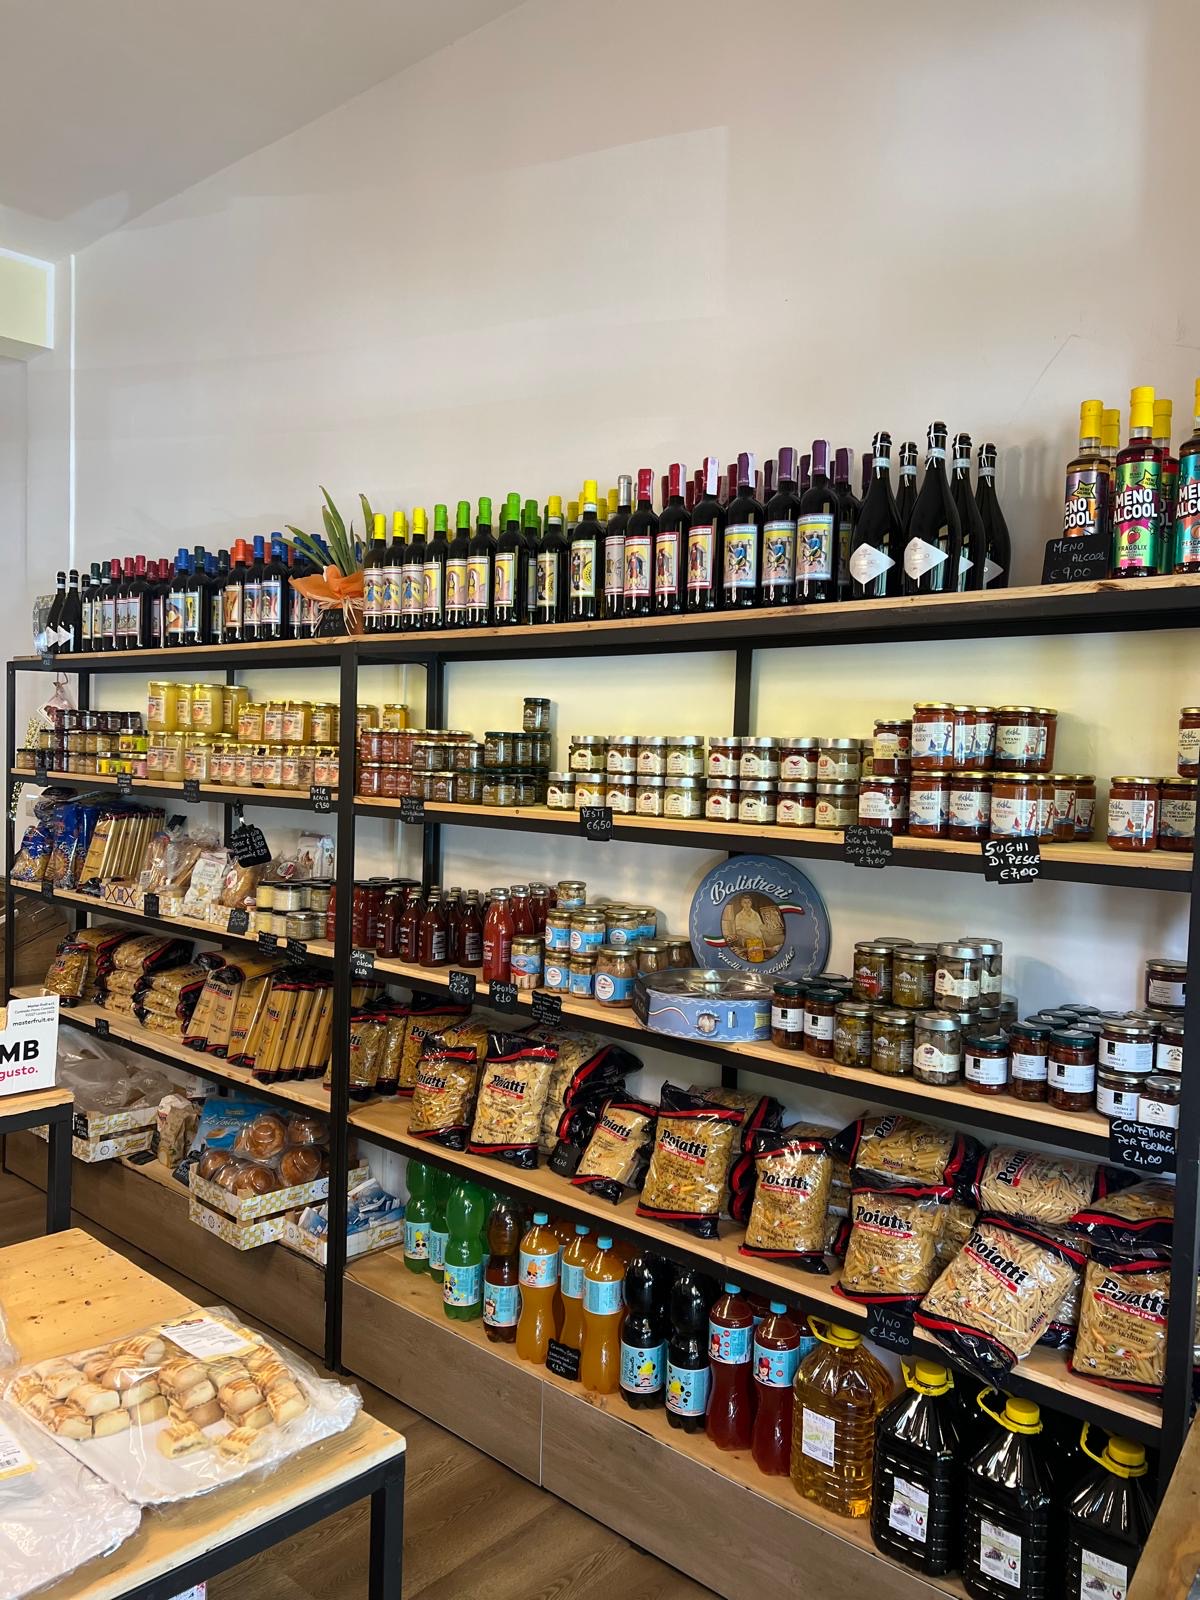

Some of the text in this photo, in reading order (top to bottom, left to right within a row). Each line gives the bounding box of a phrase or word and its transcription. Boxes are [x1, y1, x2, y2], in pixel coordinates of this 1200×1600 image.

[1115, 489, 1153, 508] MENO
[1113, 503, 1158, 525] ALCOOL
[1053, 541, 1084, 554] MENO
[1072, 552, 1105, 563] ALCOOL
[586, 819, 611, 831] €6,50
[984, 841, 1028, 856] SUGHI
[989, 853, 1040, 866] DI PESCE
[710, 875, 793, 906] Balistreri
[12, 1017, 55, 1027] masterfruit.eu
[489, 1074, 526, 1094] Poiatti
[600, 1116, 632, 1138] Poiatti
[1111, 1120, 1172, 1141] CONFETTURE
[660, 1129, 708, 1158] Poiatti
[1123, 1149, 1162, 1165] €4,00
[761, 1170, 810, 1190] Poiatti
[855, 1205, 913, 1232] Poiatti
[967, 1232, 1030, 1285] Poiatti
[1097, 1278, 1169, 1316] Poiatti
[873, 1308, 901, 1329] VINO
[869, 1326, 910, 1345] €15,00
